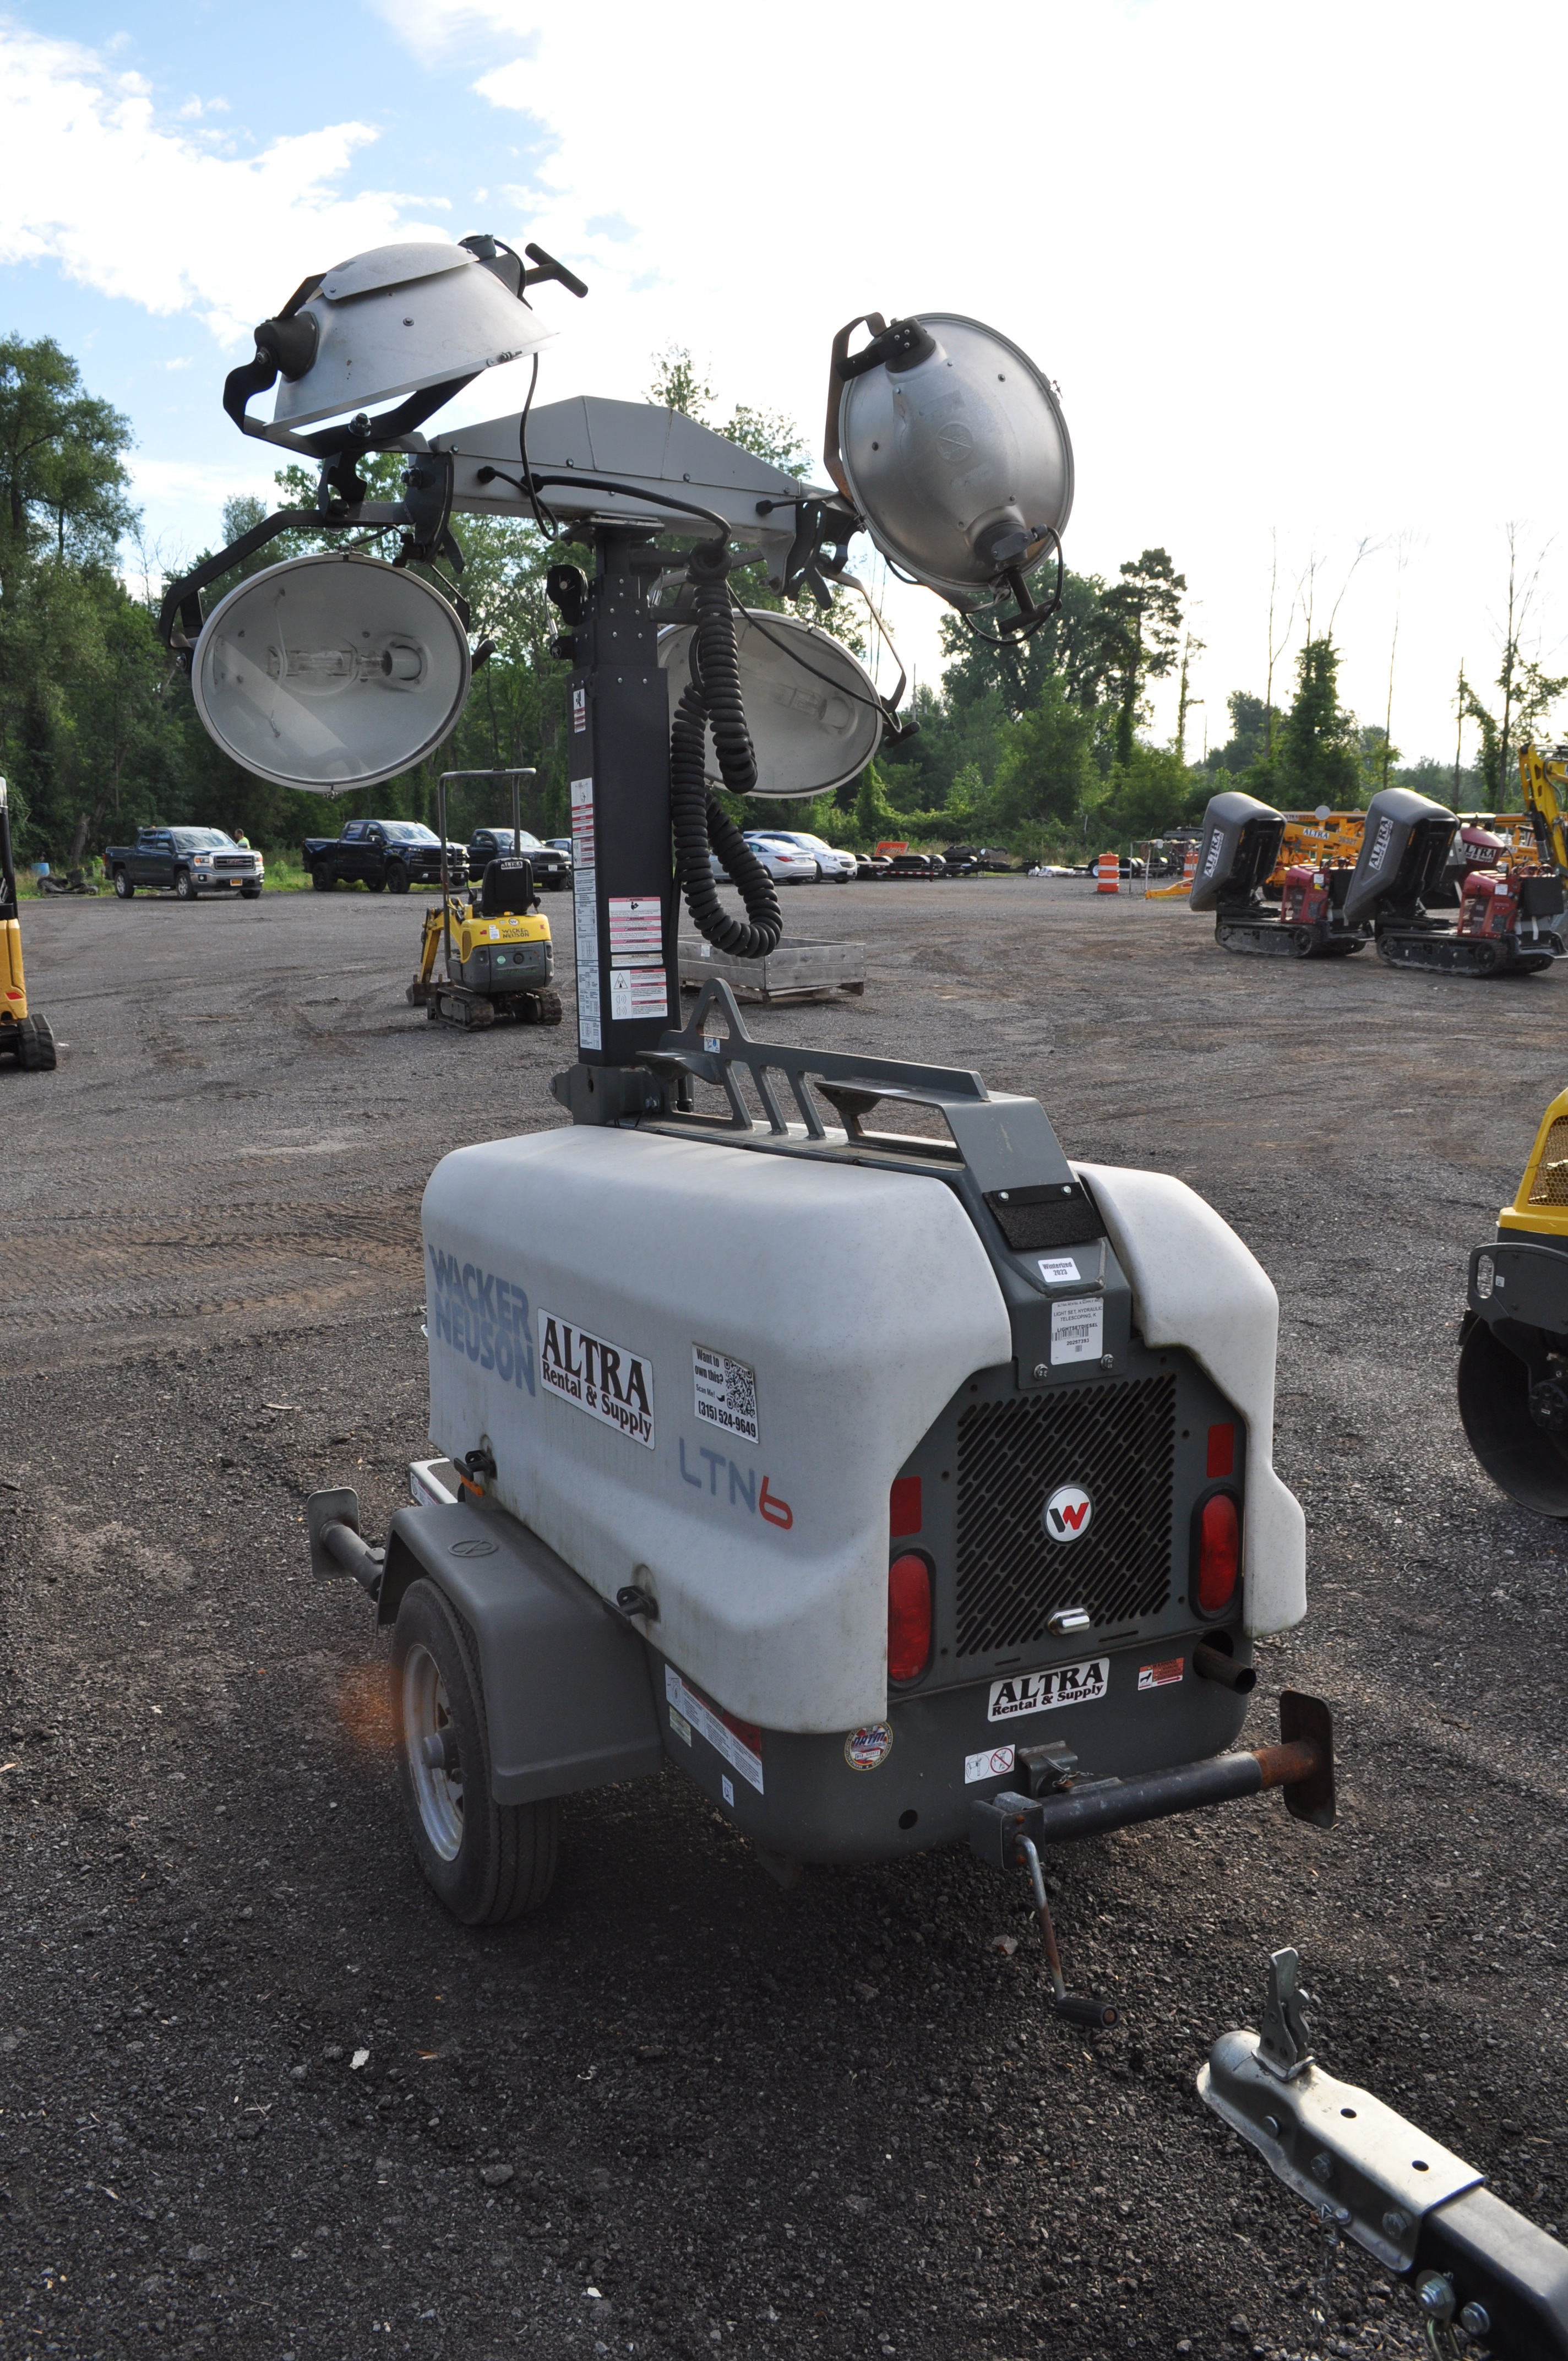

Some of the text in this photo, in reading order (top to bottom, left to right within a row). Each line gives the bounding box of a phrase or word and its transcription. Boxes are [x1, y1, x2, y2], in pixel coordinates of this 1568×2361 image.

[1304, 829, 1328, 839] ALTRA
[1371, 820, 1388, 867] ALTRA
[1206, 833, 1220, 874] ALTRA
[1465, 845, 1494, 857] LTRA
[1042, 1261, 1072, 1270] Winterized
[428, 1244, 532, 1343] WACKER
[1057, 1323, 1098, 1332] LIGHTSETDIESEL
[434, 1292, 535, 1397] NEUSON
[696, 1348, 720, 1367] Want to
[542, 1317, 652, 1417] ALTRA
[695, 1366, 724, 1385] own this?
[542, 1360, 652, 1443] Rental & Supply
[696, 1384, 715, 1398] Scan Me!
[698, 1400, 756, 1438] (315) 524-9649
[1049, 1502, 1090, 1533] W
[992, 1684, 1104, 1716] Rental & Supply
[993, 1662, 1104, 1707] ALTRA
